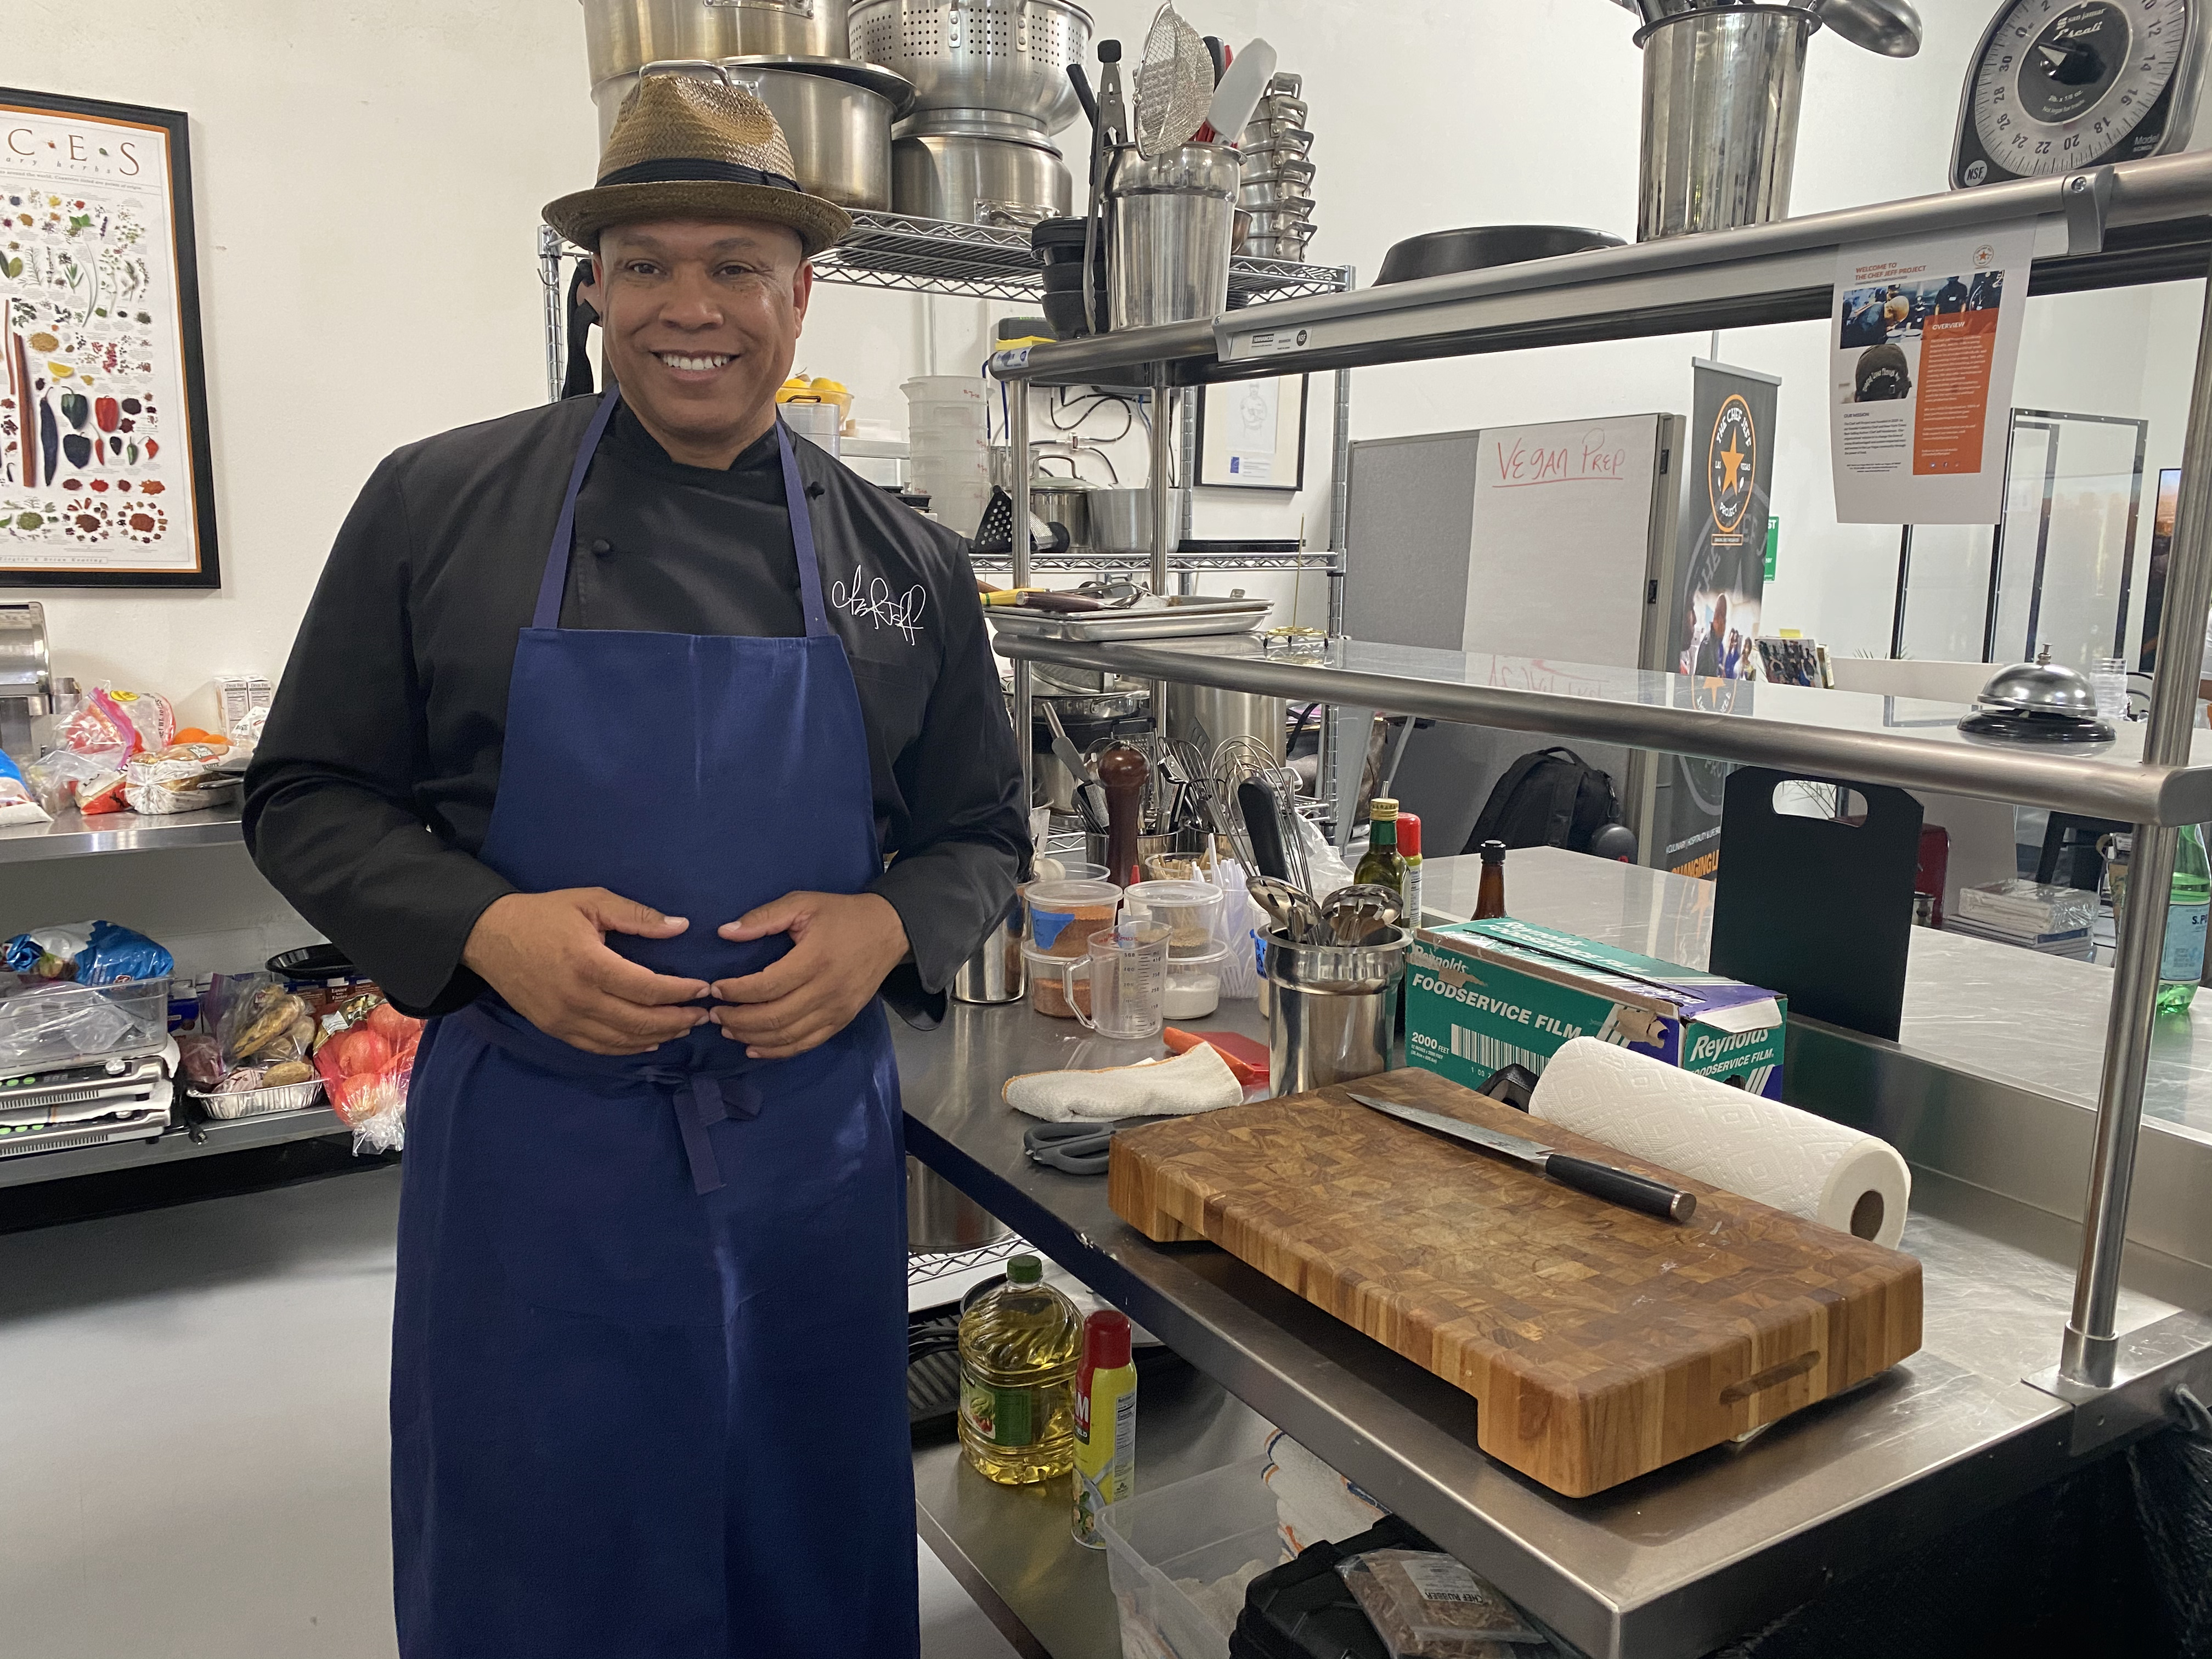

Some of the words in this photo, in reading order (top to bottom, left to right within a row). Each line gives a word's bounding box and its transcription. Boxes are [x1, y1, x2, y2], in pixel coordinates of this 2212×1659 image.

[2041, 1, 2050, 12] 2
[2053, 21, 2103, 41] Escali
[2148, 19, 2162, 38] 12
[1999, 55, 2012, 72] 30
[2140, 54, 2158, 72] 14
[1994, 86, 2005, 104] 28
[2121, 89, 2138, 106] 16
[1997, 113, 2011, 130] 26
[2094, 116, 2111, 133] 18
[2012, 133, 2029, 149] 24
[2035, 140, 2052, 154] 22
[2064, 133, 2080, 150] 20
[1967, 166, 1984, 181] NSF
[1856, 263, 1886, 273] WELCOME
[1884, 269, 1898, 277] JEFF
[1898, 264, 1927, 275] PROJECT
[1932, 321, 1965, 330] OVERVIEW
[1297, 334, 1306, 342] NSF
[1716, 416, 1728, 443] THE
[1726, 407, 1743, 422] CHEF
[1740, 417, 1752, 447] JEFF
[1719, 502, 1737, 517] PROJECT
[1496, 922, 1589, 947] Reynolds
[1479, 924, 1604, 960] FOODSERVICE
[1601, 956, 1651, 973] FILM
[1412, 973, 1531, 1025] FOODSERVICE
[1534, 1012, 1583, 1040] FILM
[1411, 1031, 1438, 1049] 2000
[1438, 1045, 1450, 1054] FEET
[1689, 1028, 1769, 1063] Reynolds
[1691, 1054, 1751, 1077] OODSERVICE
[1751, 1048, 1773, 1064] FILM
[1425, 1592, 1462, 1601] RUBBER
[1462, 1593, 1484, 1604] CHEF
